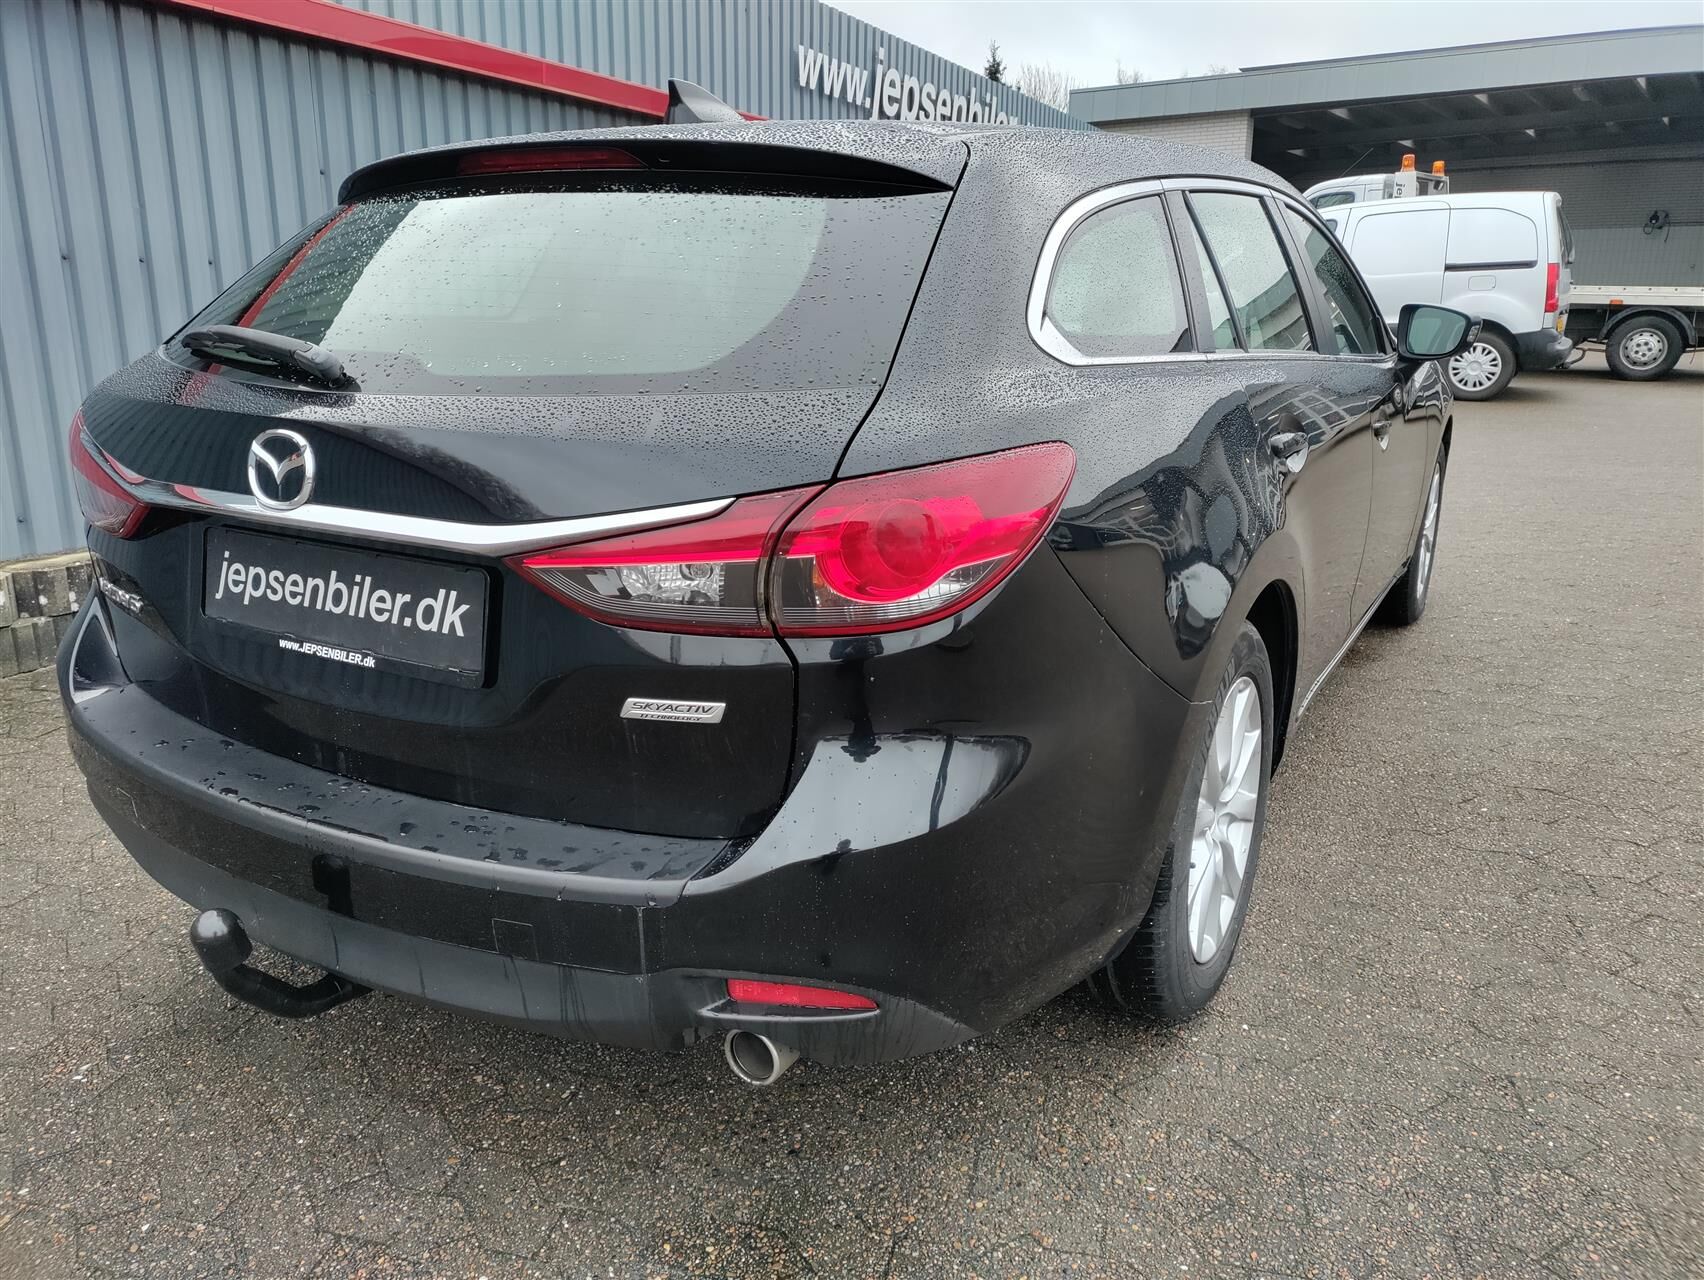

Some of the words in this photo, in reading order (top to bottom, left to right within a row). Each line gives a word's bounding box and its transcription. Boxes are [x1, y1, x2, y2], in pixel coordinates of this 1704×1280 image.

[798, 44, 1018, 125] www.jepsenbil
[1394, 181, 1406, 199] je
[215, 550, 470, 637] jepsenbiler.dk
[279, 637, 376, 668] www.JEPSENBILER.dk
[631, 701, 714, 714] SKYACTIV
[639, 713, 702, 722] TECHNOLOGY
